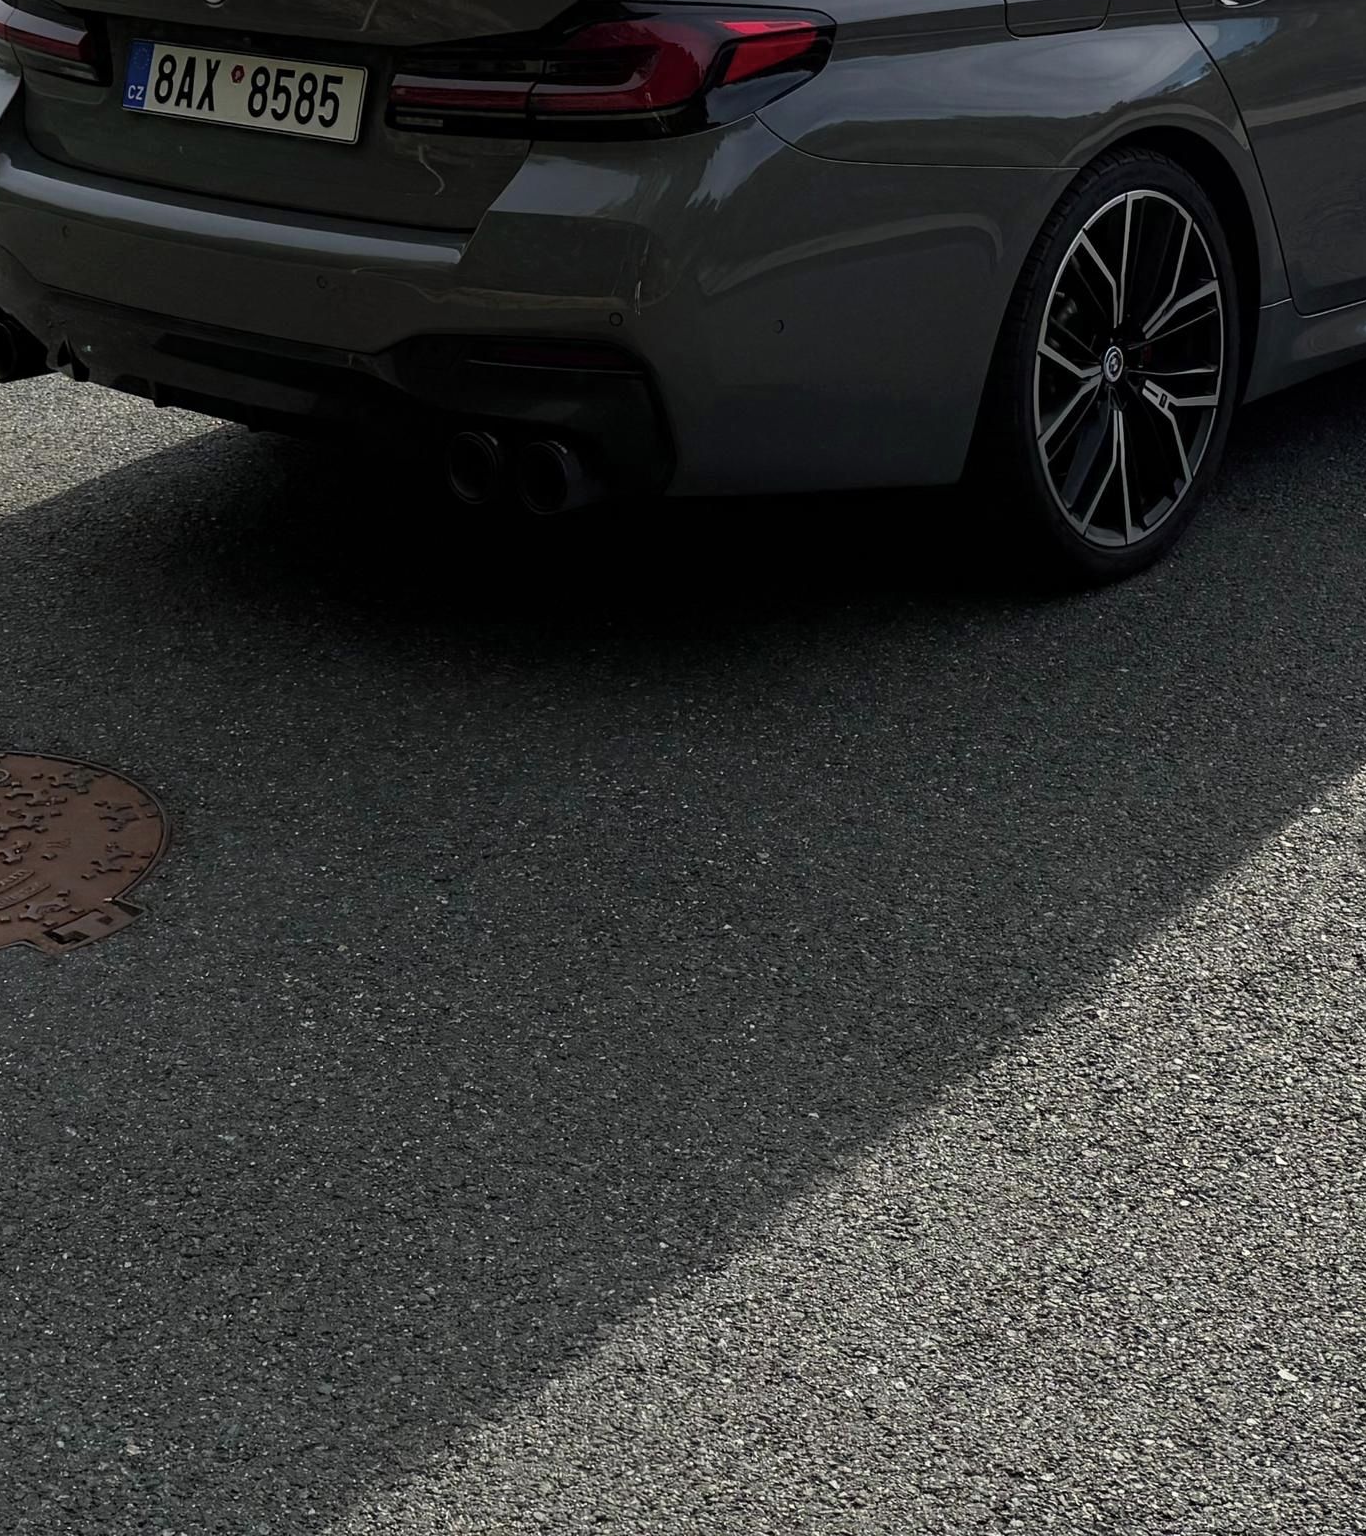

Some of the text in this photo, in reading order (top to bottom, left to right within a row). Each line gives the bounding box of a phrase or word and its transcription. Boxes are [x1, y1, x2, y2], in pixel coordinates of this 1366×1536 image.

[127, 84, 144, 101] CZ
[153, 53, 344, 129] 8AX 8585
